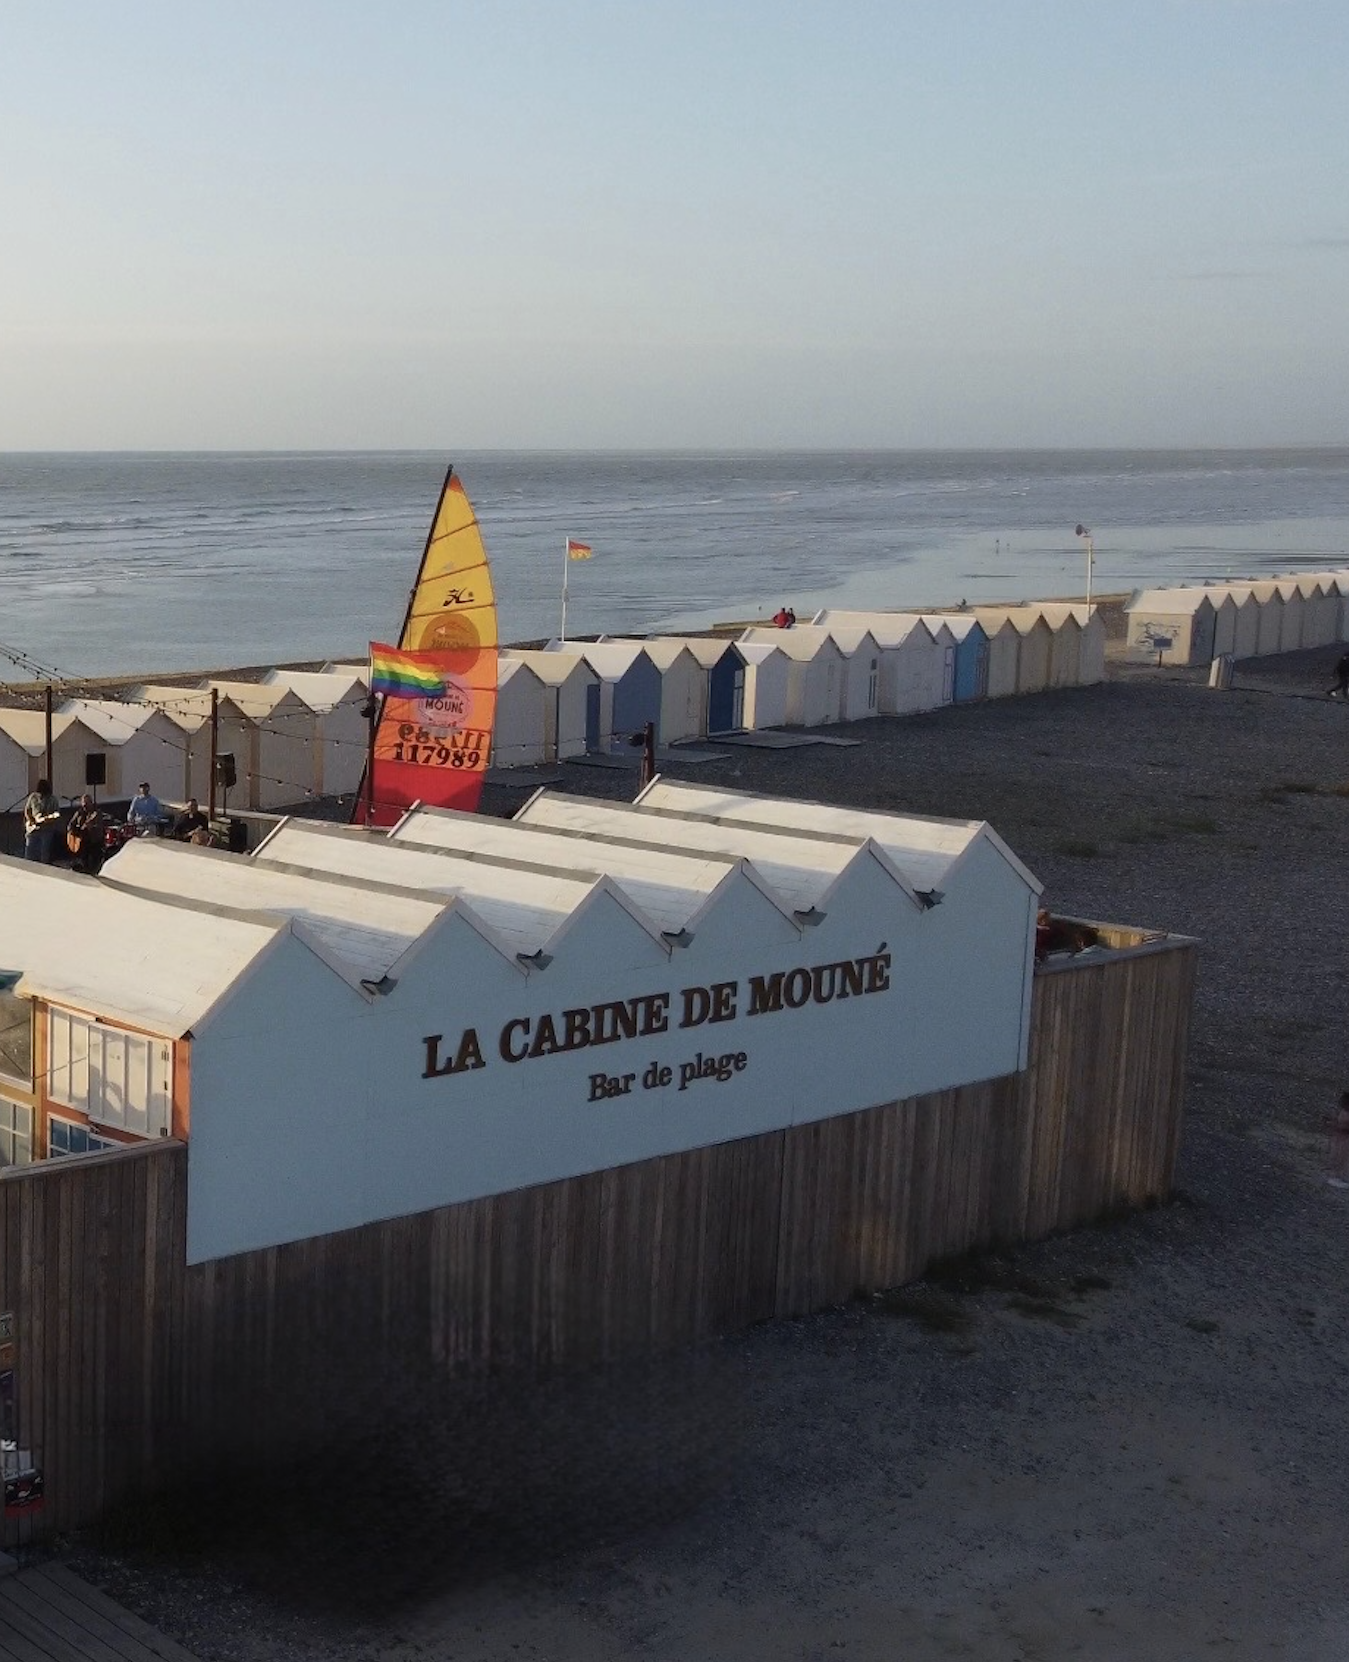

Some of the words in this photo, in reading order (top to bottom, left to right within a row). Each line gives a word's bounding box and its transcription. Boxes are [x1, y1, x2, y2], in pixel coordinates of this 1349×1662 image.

[393, 742, 480, 769] 117989
[421, 1028, 486, 1079] LA
[499, 992, 671, 1063] CABINE
[678, 981, 738, 1029] DE
[746, 942, 891, 1016] MOUNÉ
[587, 1073, 636, 1102] Bar
[642, 1061, 672, 1089] de
[678, 1051, 747, 1091] plage
